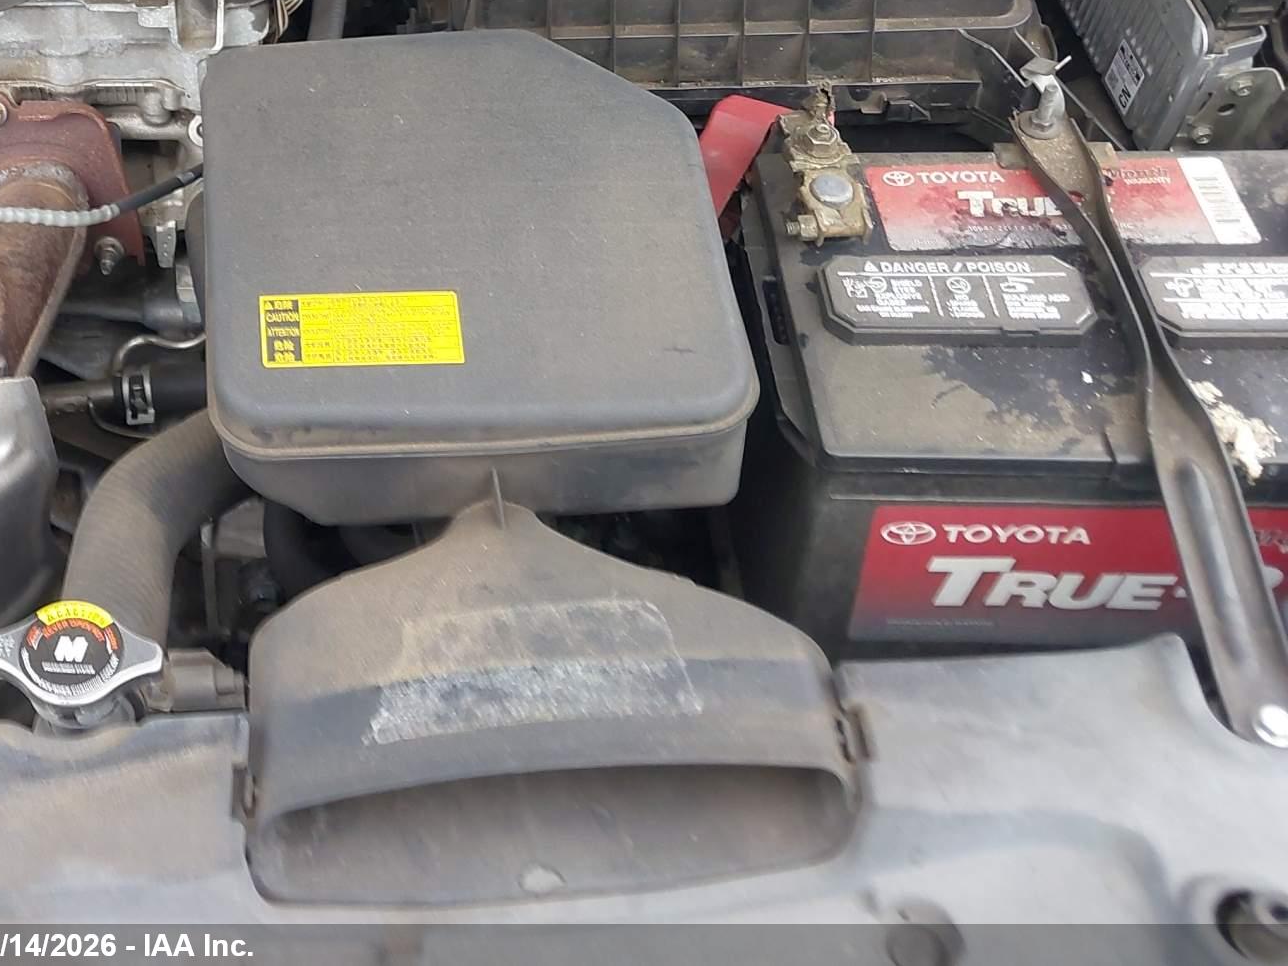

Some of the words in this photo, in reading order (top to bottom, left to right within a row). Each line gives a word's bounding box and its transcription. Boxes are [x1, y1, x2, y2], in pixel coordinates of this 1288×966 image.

[916, 170, 1005, 184] TOYOTA
[881, 261, 950, 274] DANGER
[967, 261, 1032, 273] POISON
[265, 312, 300, 323] CAUTION
[942, 523, 1092, 545] TOYOTA
[926, 555, 1183, 611] TRUE
